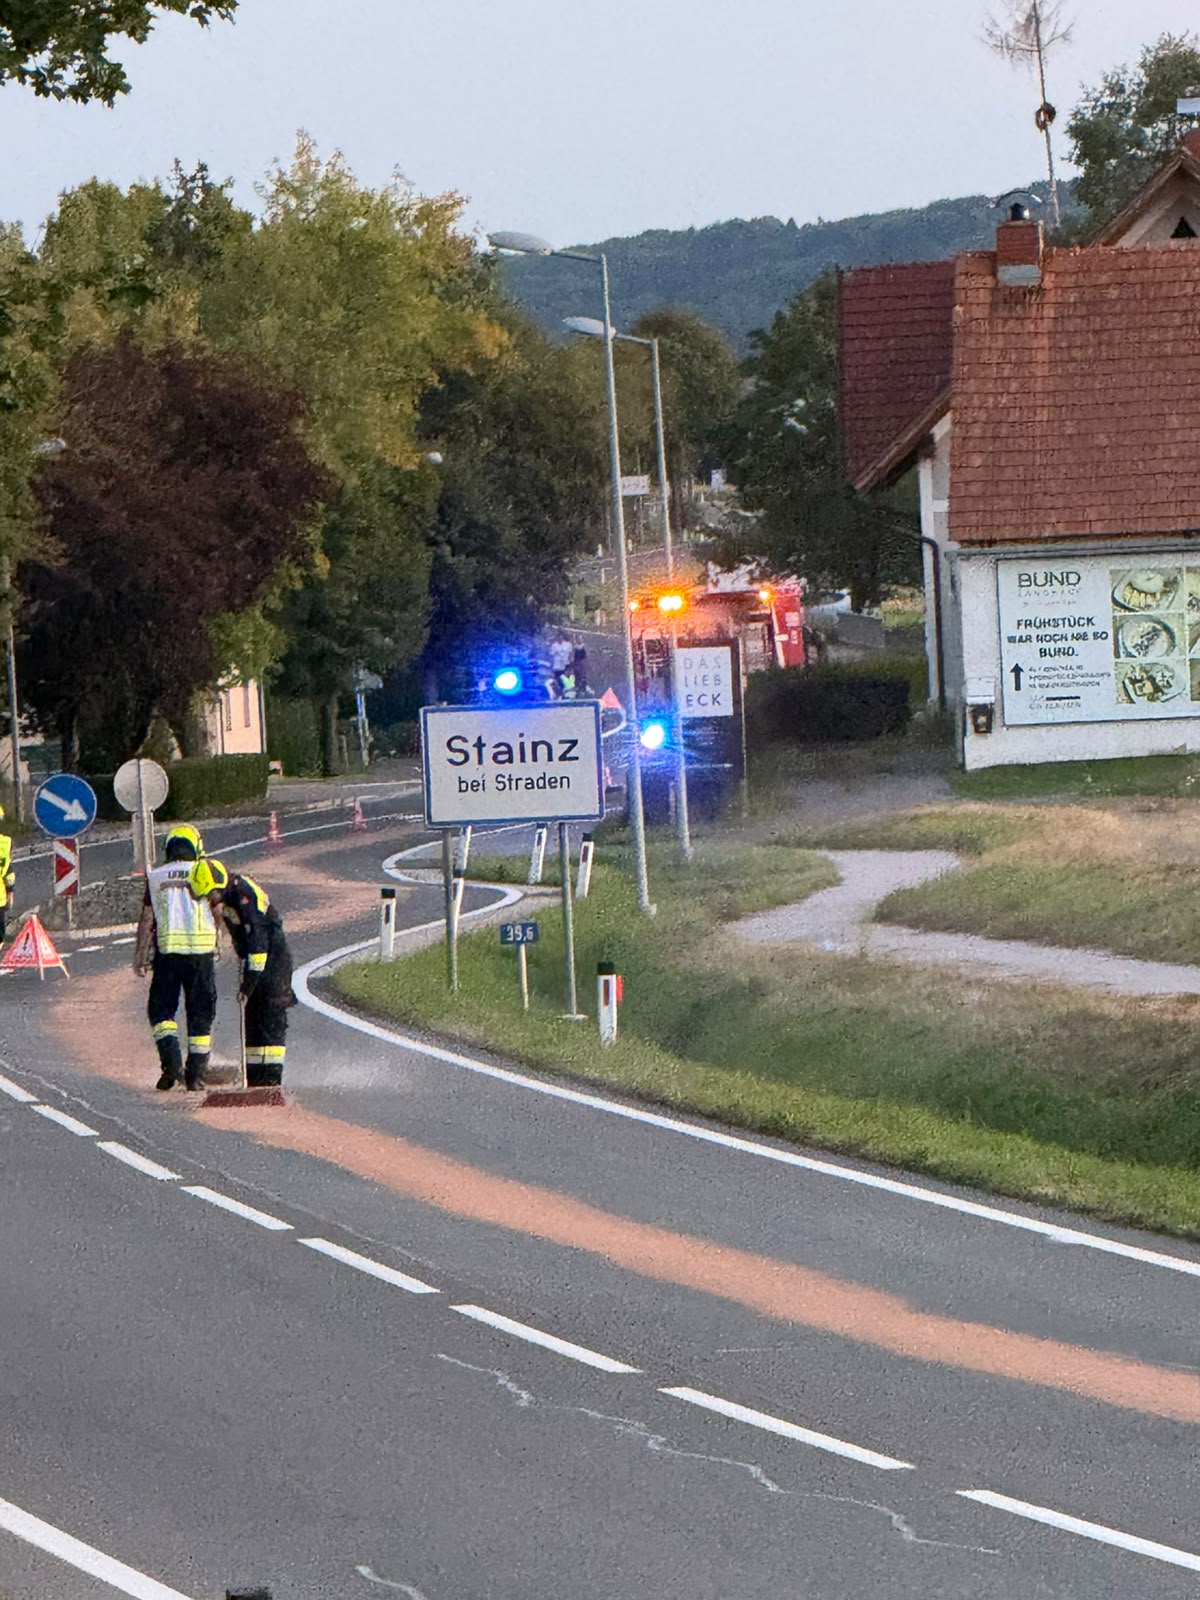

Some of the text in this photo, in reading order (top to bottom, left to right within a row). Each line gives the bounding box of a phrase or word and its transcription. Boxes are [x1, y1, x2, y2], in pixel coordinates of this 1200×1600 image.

[1017, 571, 1081, 588] BUND
[1016, 615, 1096, 630] FRÜHSTÜCK
[683, 656, 722, 670] DAS
[685, 693, 722, 707] ECK
[446, 732, 580, 767] Stainz
[457, 772, 571, 793] bei Straden
